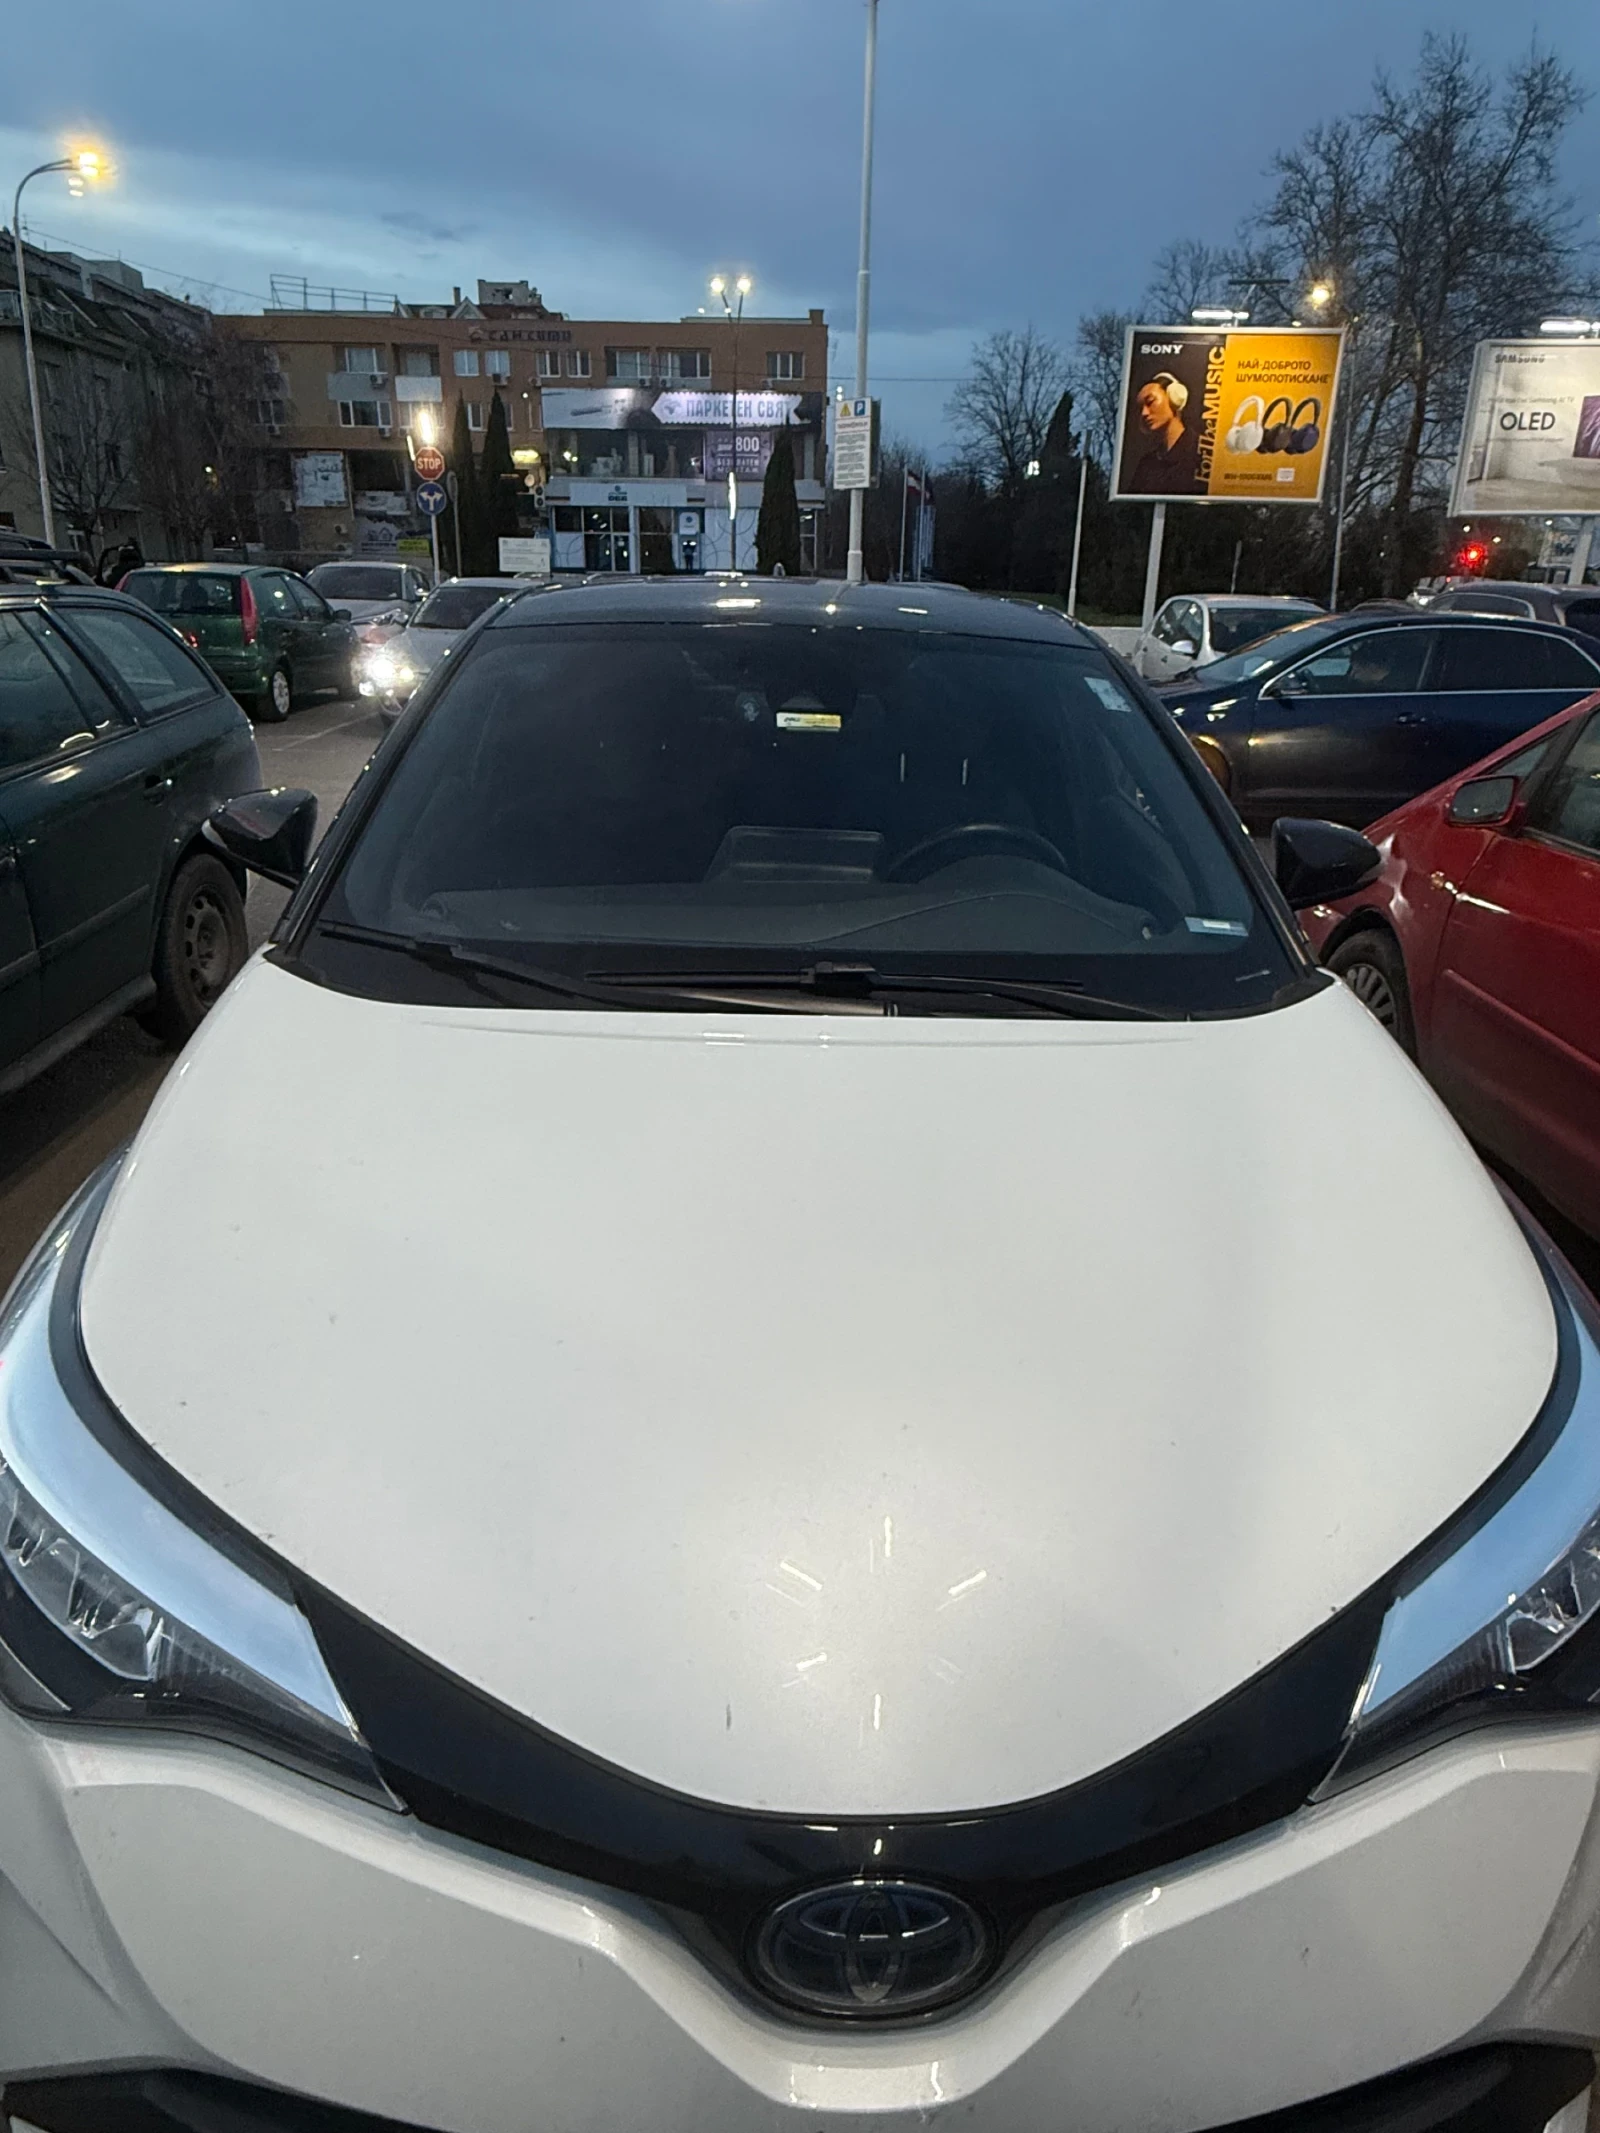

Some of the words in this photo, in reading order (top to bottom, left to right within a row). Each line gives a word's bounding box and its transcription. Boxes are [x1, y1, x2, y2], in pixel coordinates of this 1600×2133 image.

[1141, 344, 1183, 355] SONY
[1237, 360, 1312, 371] НАЙ-ДОБРОТО
[1500, 412, 1556, 431] OLED
[735, 436, 760, 452] 800
[417, 457, 441, 470] STOP
[717, 458, 759, 467] БЕЗЛАТЕН
